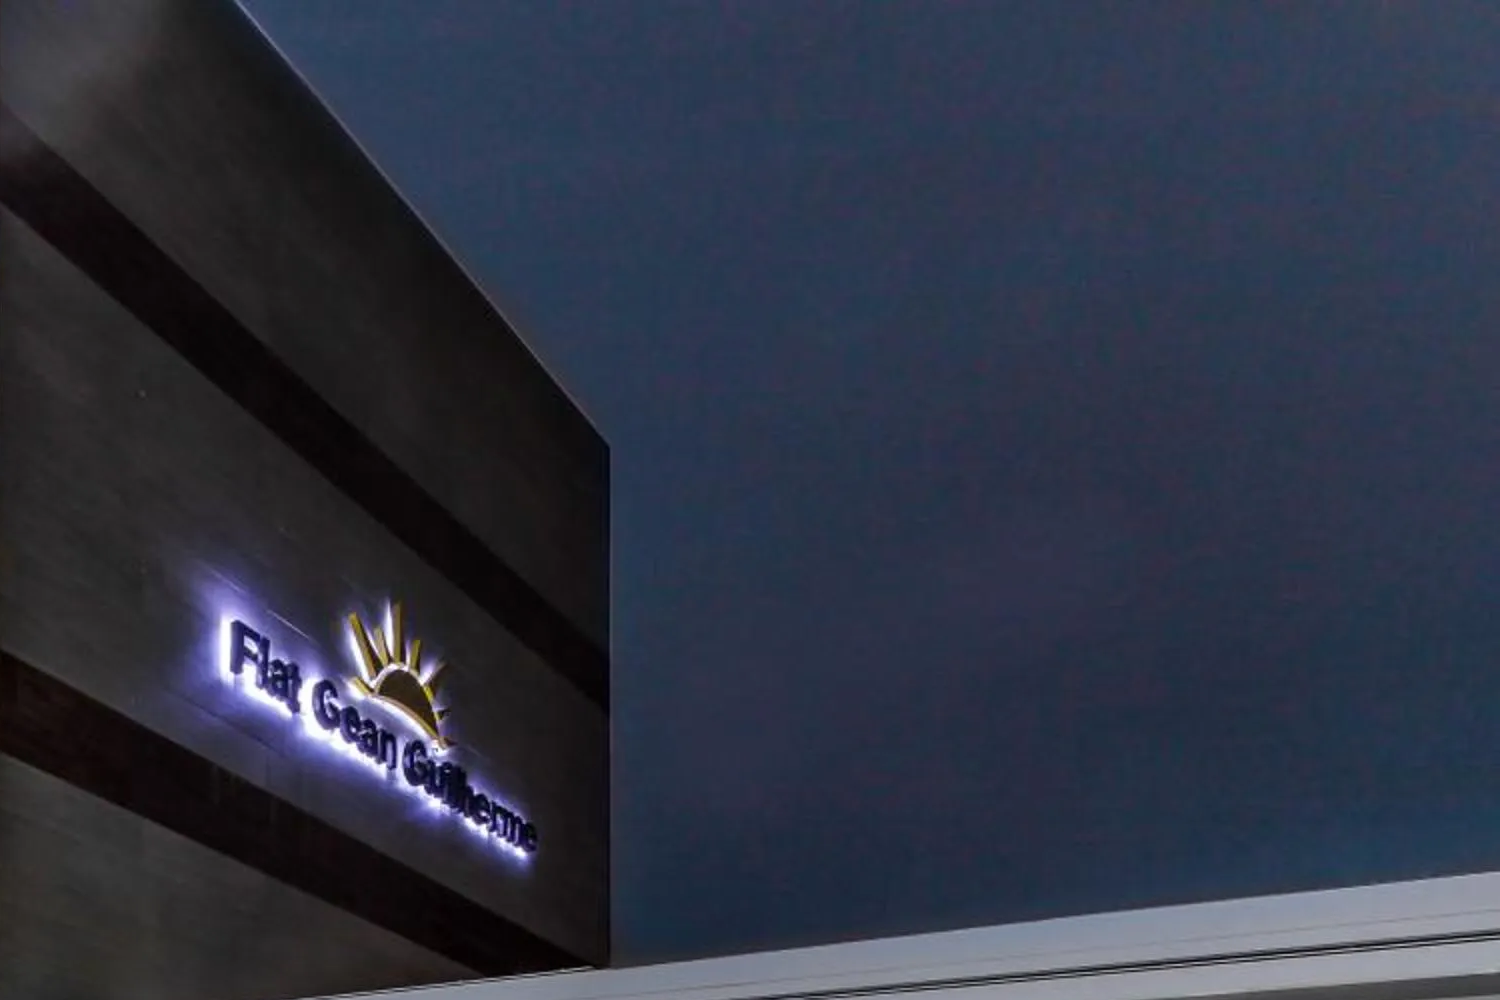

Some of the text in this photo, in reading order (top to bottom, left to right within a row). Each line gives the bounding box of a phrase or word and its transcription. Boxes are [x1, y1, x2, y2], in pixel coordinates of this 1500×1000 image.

[230, 620, 538, 853] Flat Gean Guilherme
